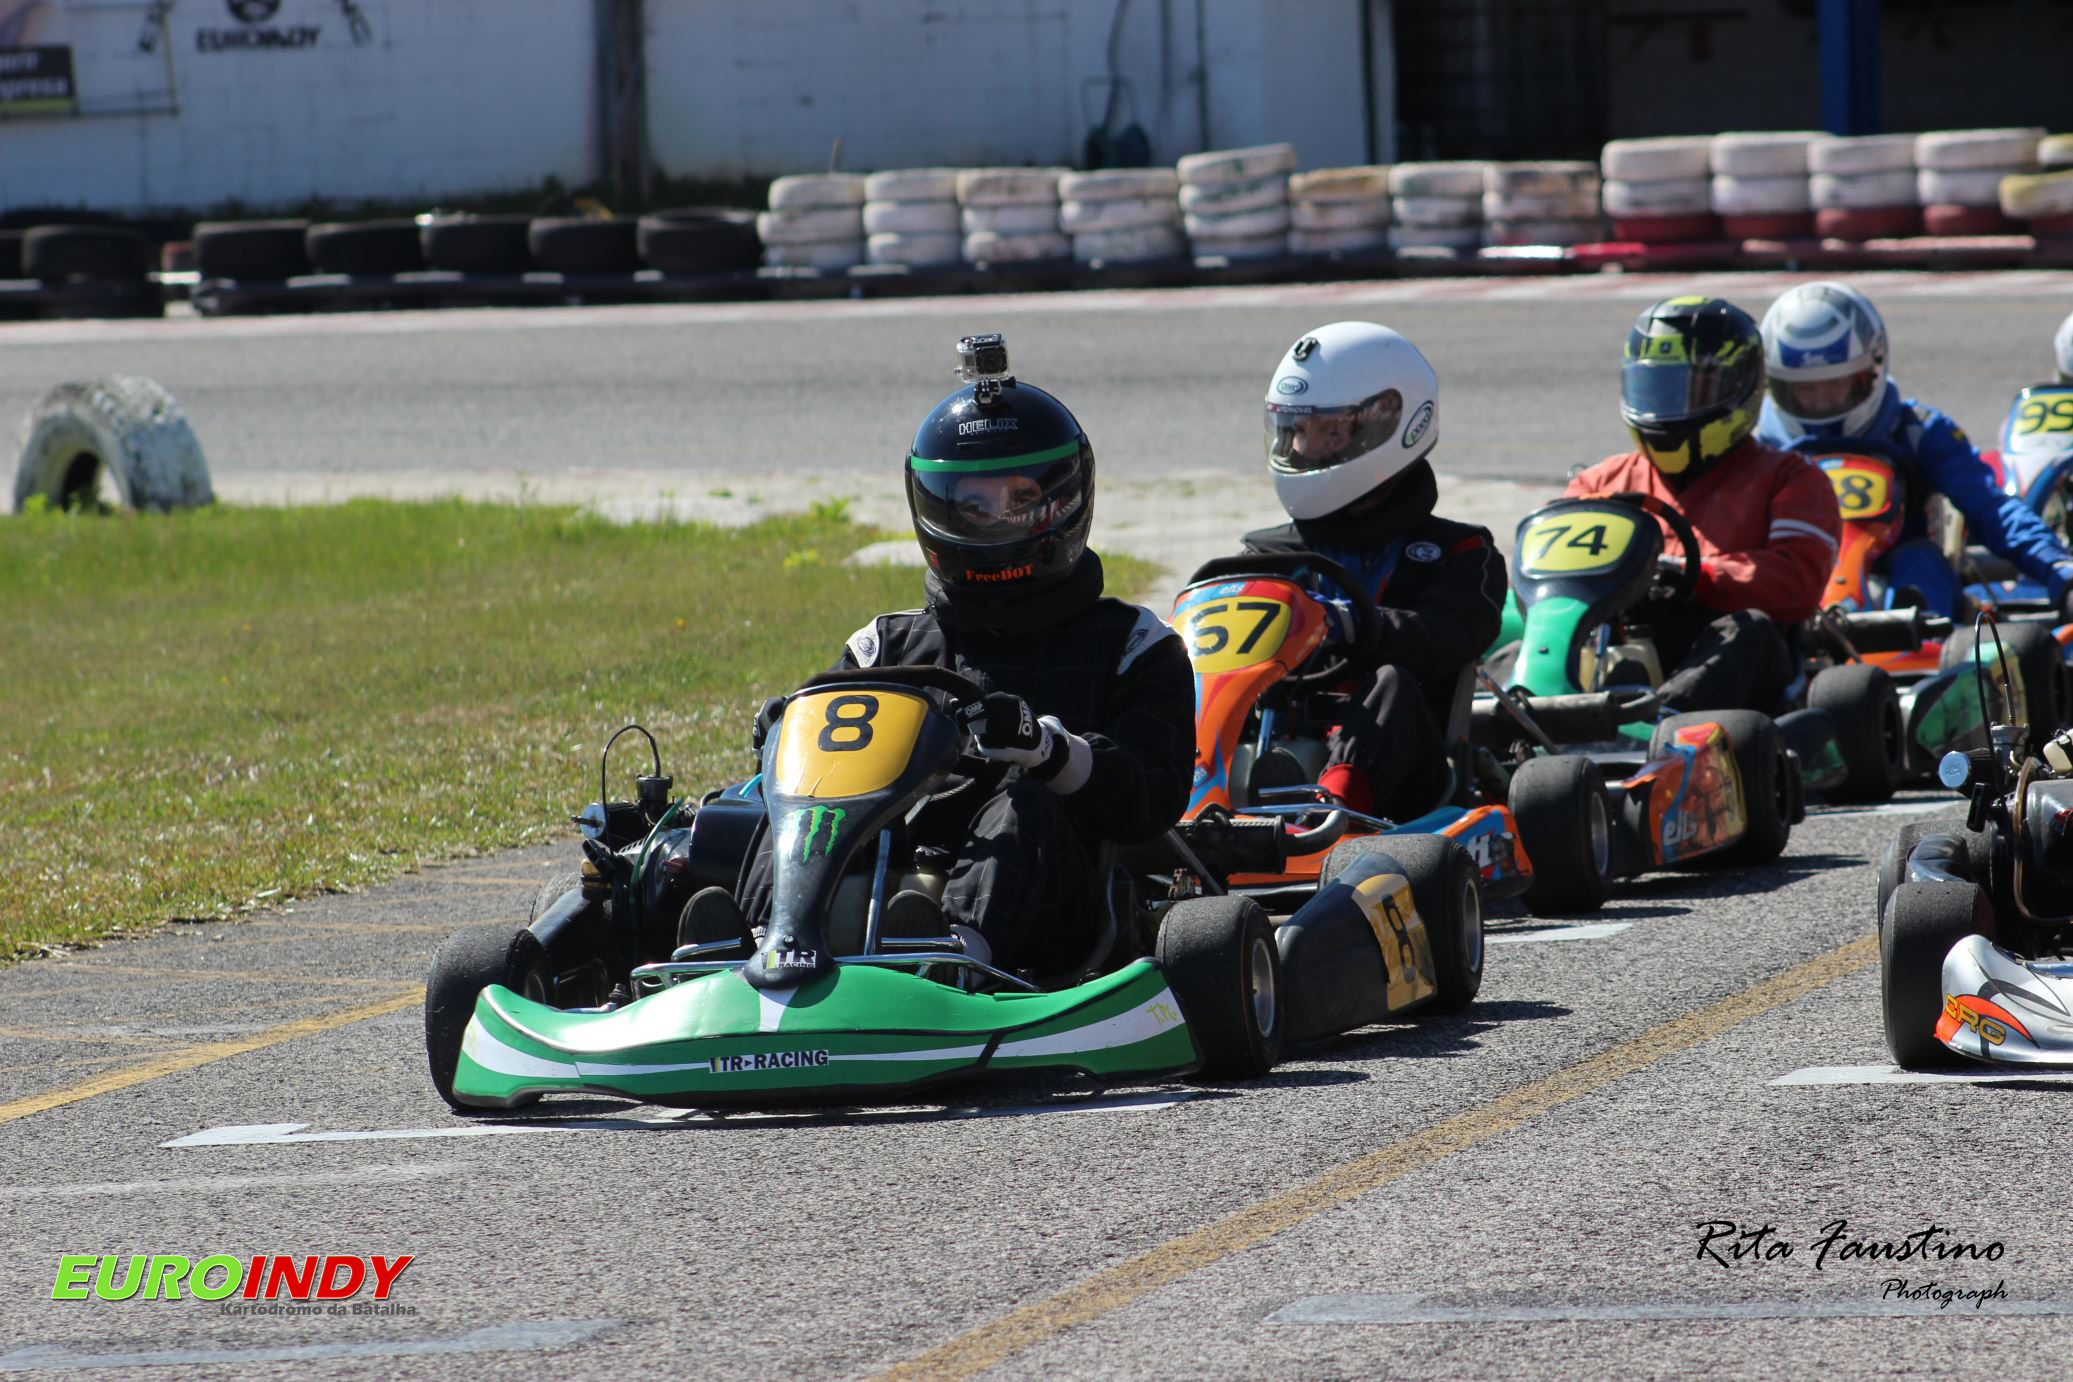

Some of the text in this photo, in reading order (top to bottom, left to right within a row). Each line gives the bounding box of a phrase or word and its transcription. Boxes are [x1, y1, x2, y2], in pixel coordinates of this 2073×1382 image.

[959, 418, 1019, 435] HELIX
[1535, 525, 1609, 560] 74
[817, 694, 880, 752] 8
[1945, 992, 2007, 1046] CRG
